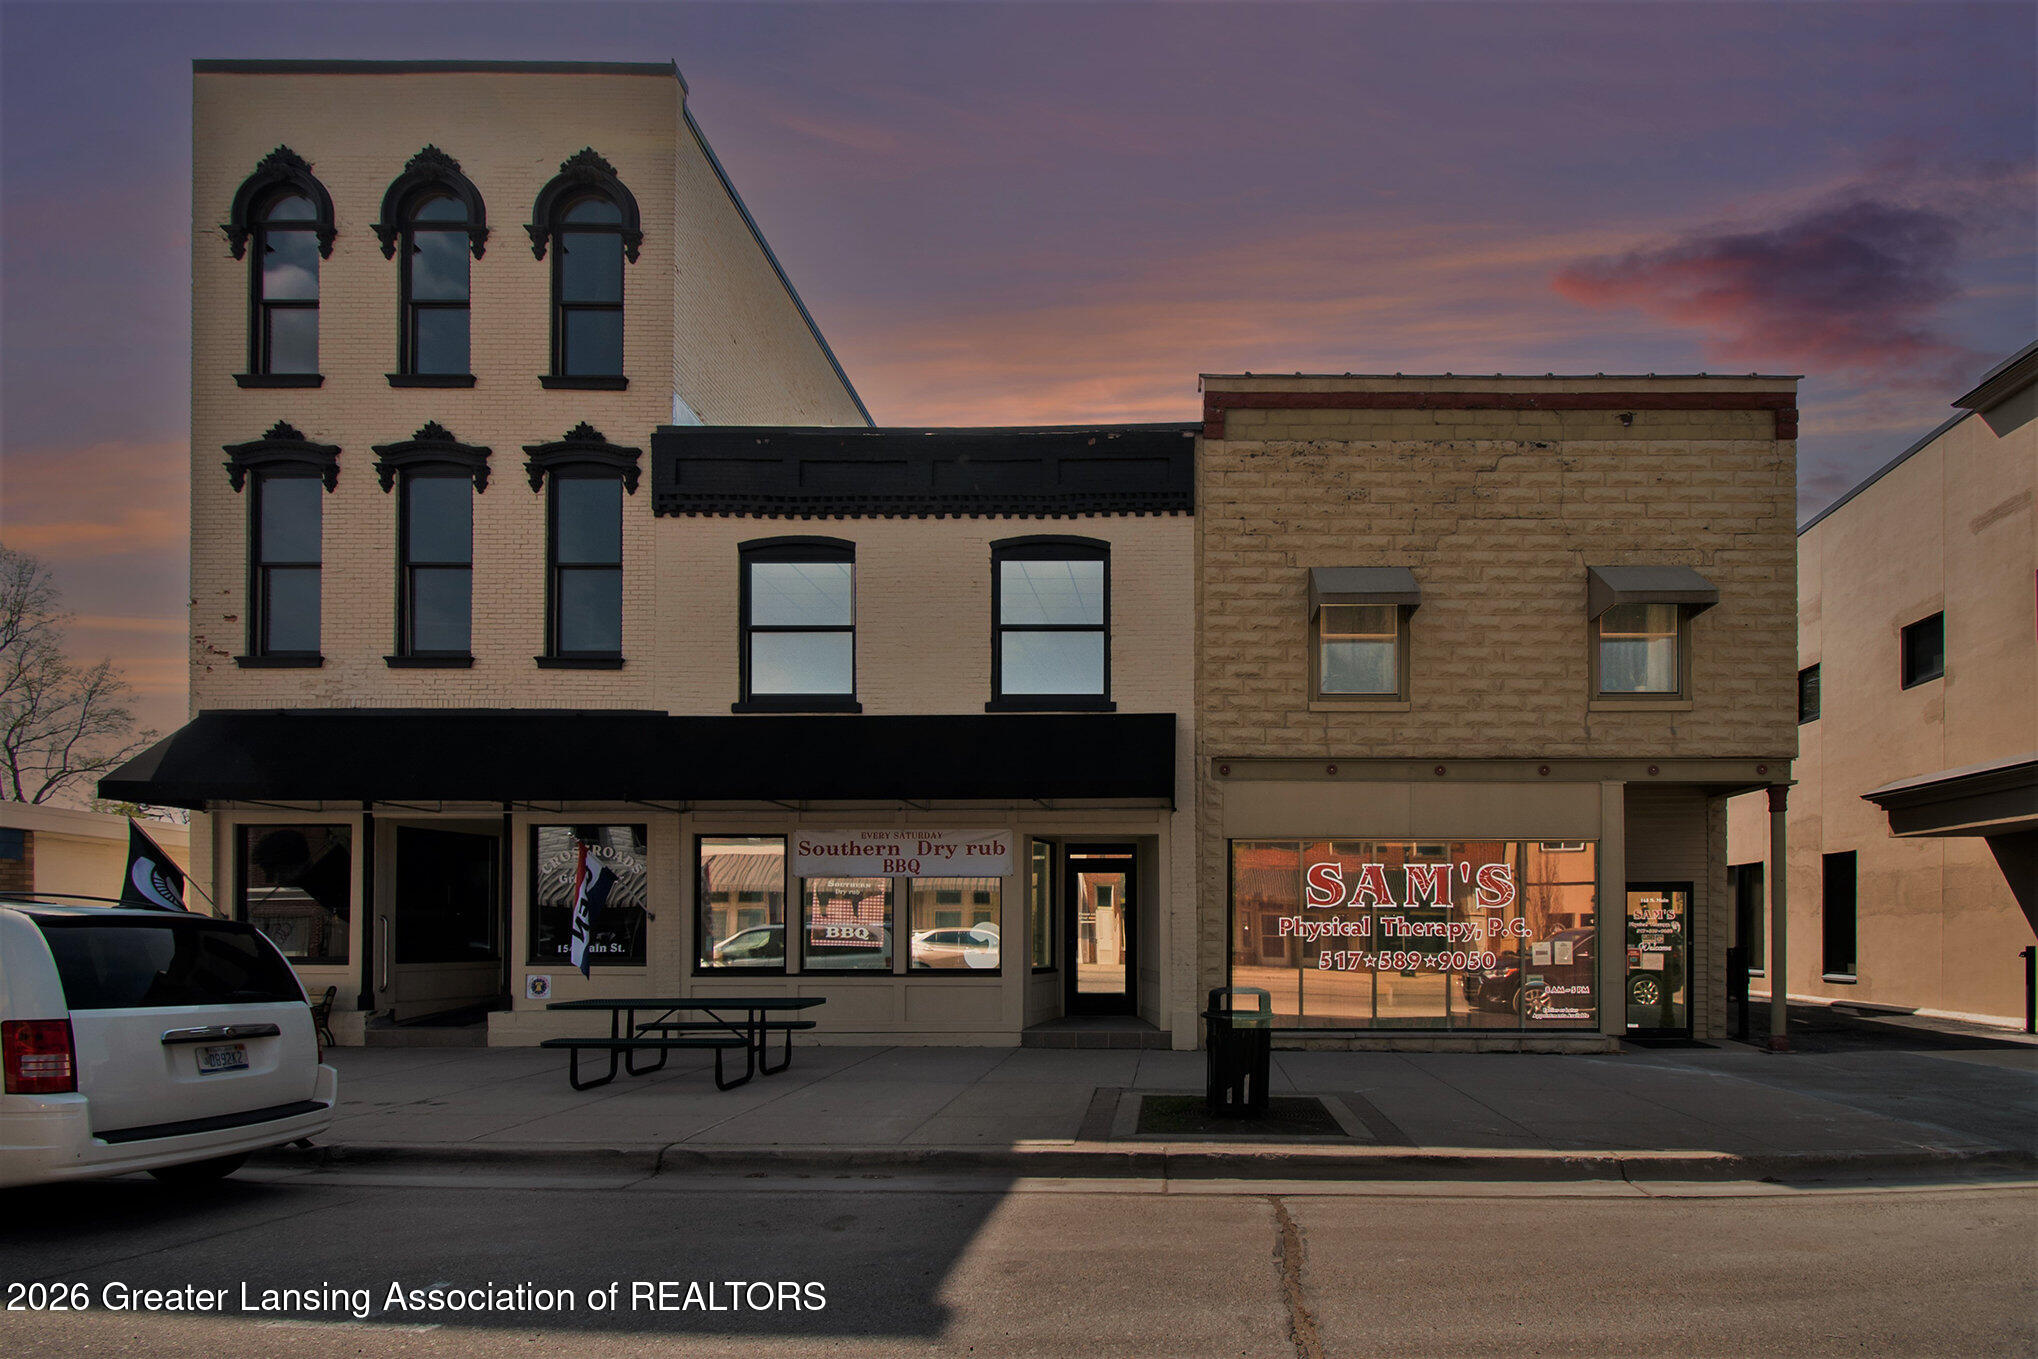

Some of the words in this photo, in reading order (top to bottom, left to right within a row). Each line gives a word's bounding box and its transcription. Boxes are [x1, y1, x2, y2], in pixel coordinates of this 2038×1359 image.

[860, 831, 890, 840] EVERY
[893, 831, 943, 840] SATURDAY
[798, 840, 901, 857] Southern
[917, 840, 958, 860] Dry
[965, 840, 1006, 856] rub
[882, 858, 920, 875] BBQ
[1306, 861, 1516, 910] SAM'S
[1633, 909, 1676, 920] SAM'S
[826, 926, 870, 940] BBQ
[1279, 915, 1371, 943] Physical
[1380, 915, 1482, 943] Therapy,
[1488, 917, 1533, 937] P.C.
[588, 942, 607, 953] ain
[610, 942, 626, 953] St.
[1550, 985, 1565, 994] AM
[1577, 985, 1590, 994] PM
